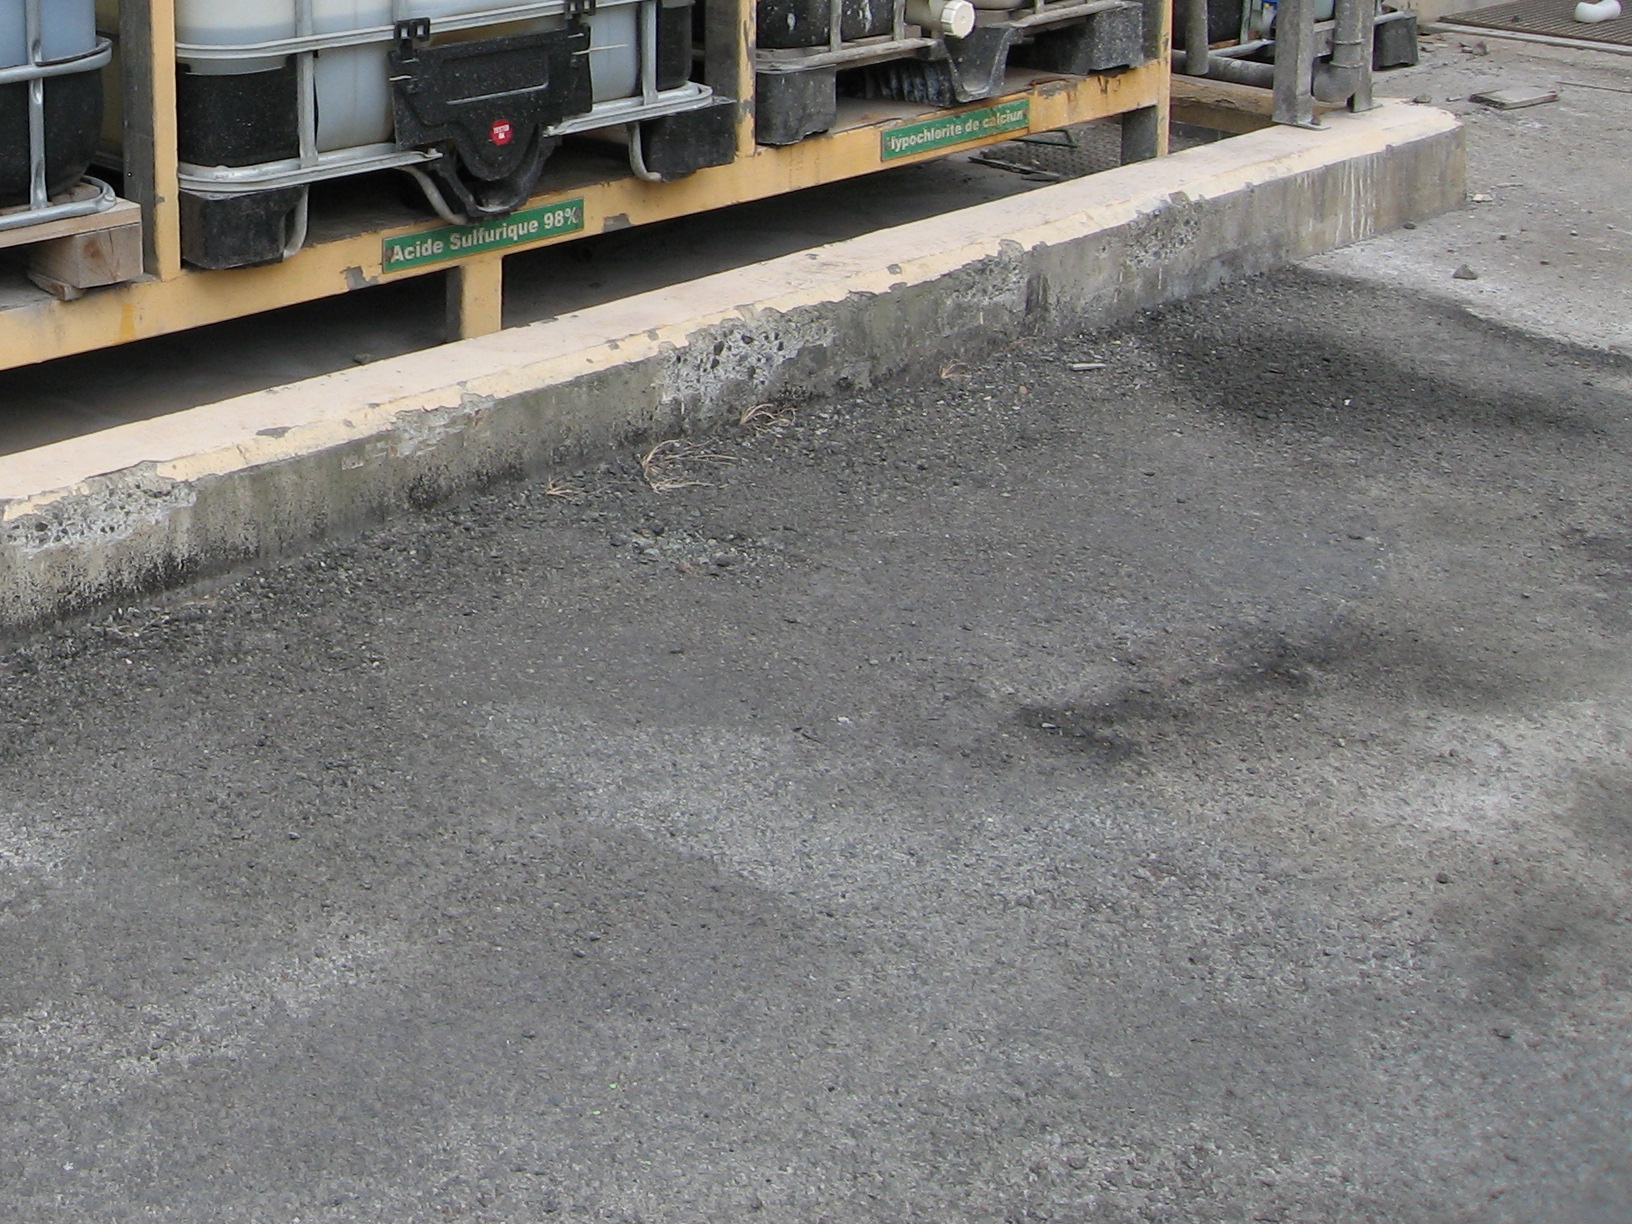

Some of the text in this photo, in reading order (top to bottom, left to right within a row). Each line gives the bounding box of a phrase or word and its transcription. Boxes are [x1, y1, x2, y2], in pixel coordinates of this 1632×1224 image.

[964, 118, 980, 133] de
[390, 206, 581, 263] Acide Sulfurique 98%
